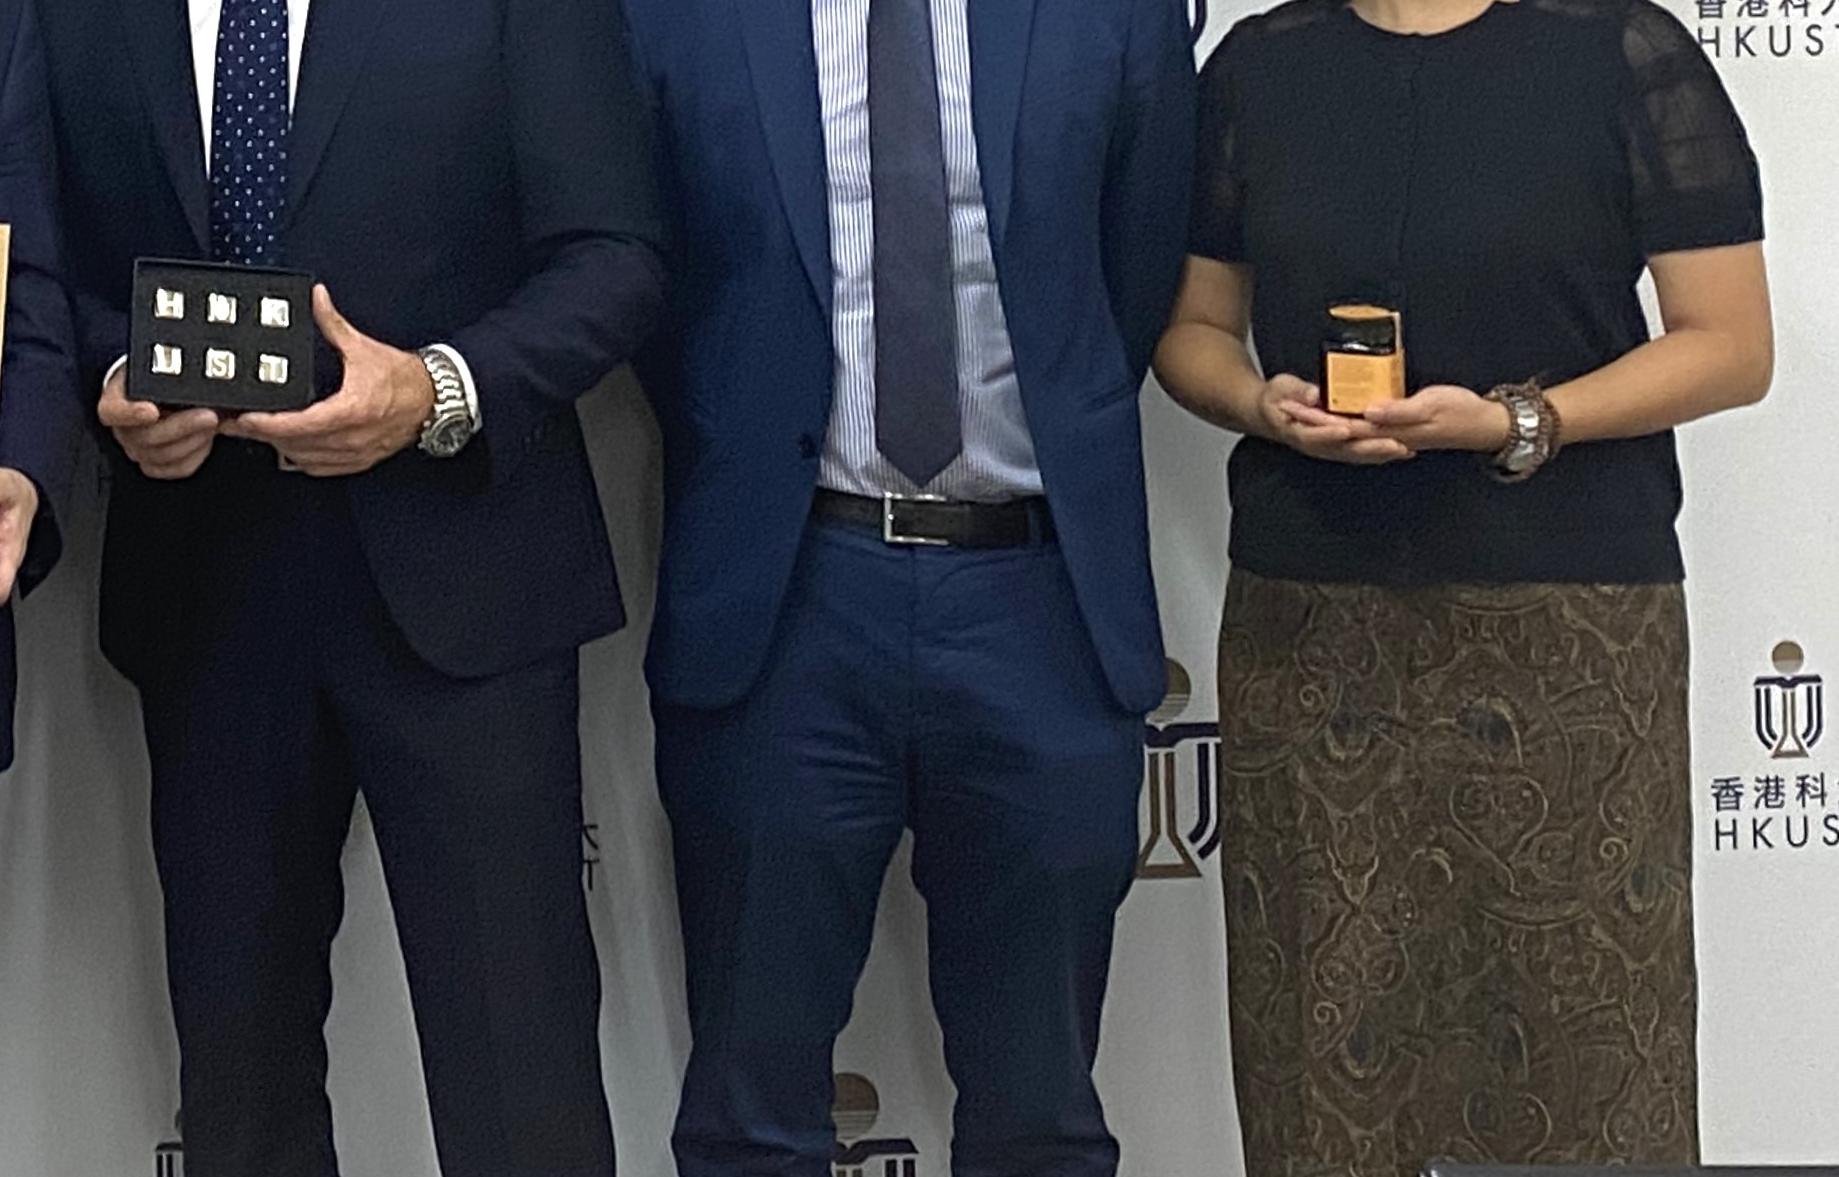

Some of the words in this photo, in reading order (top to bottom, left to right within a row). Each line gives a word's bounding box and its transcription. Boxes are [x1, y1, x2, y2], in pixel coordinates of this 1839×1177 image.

[1698, 24, 1839, 58] HKUS
[1711, 772, 1839, 812] 香港科
[1714, 814, 1839, 851] HKUS
